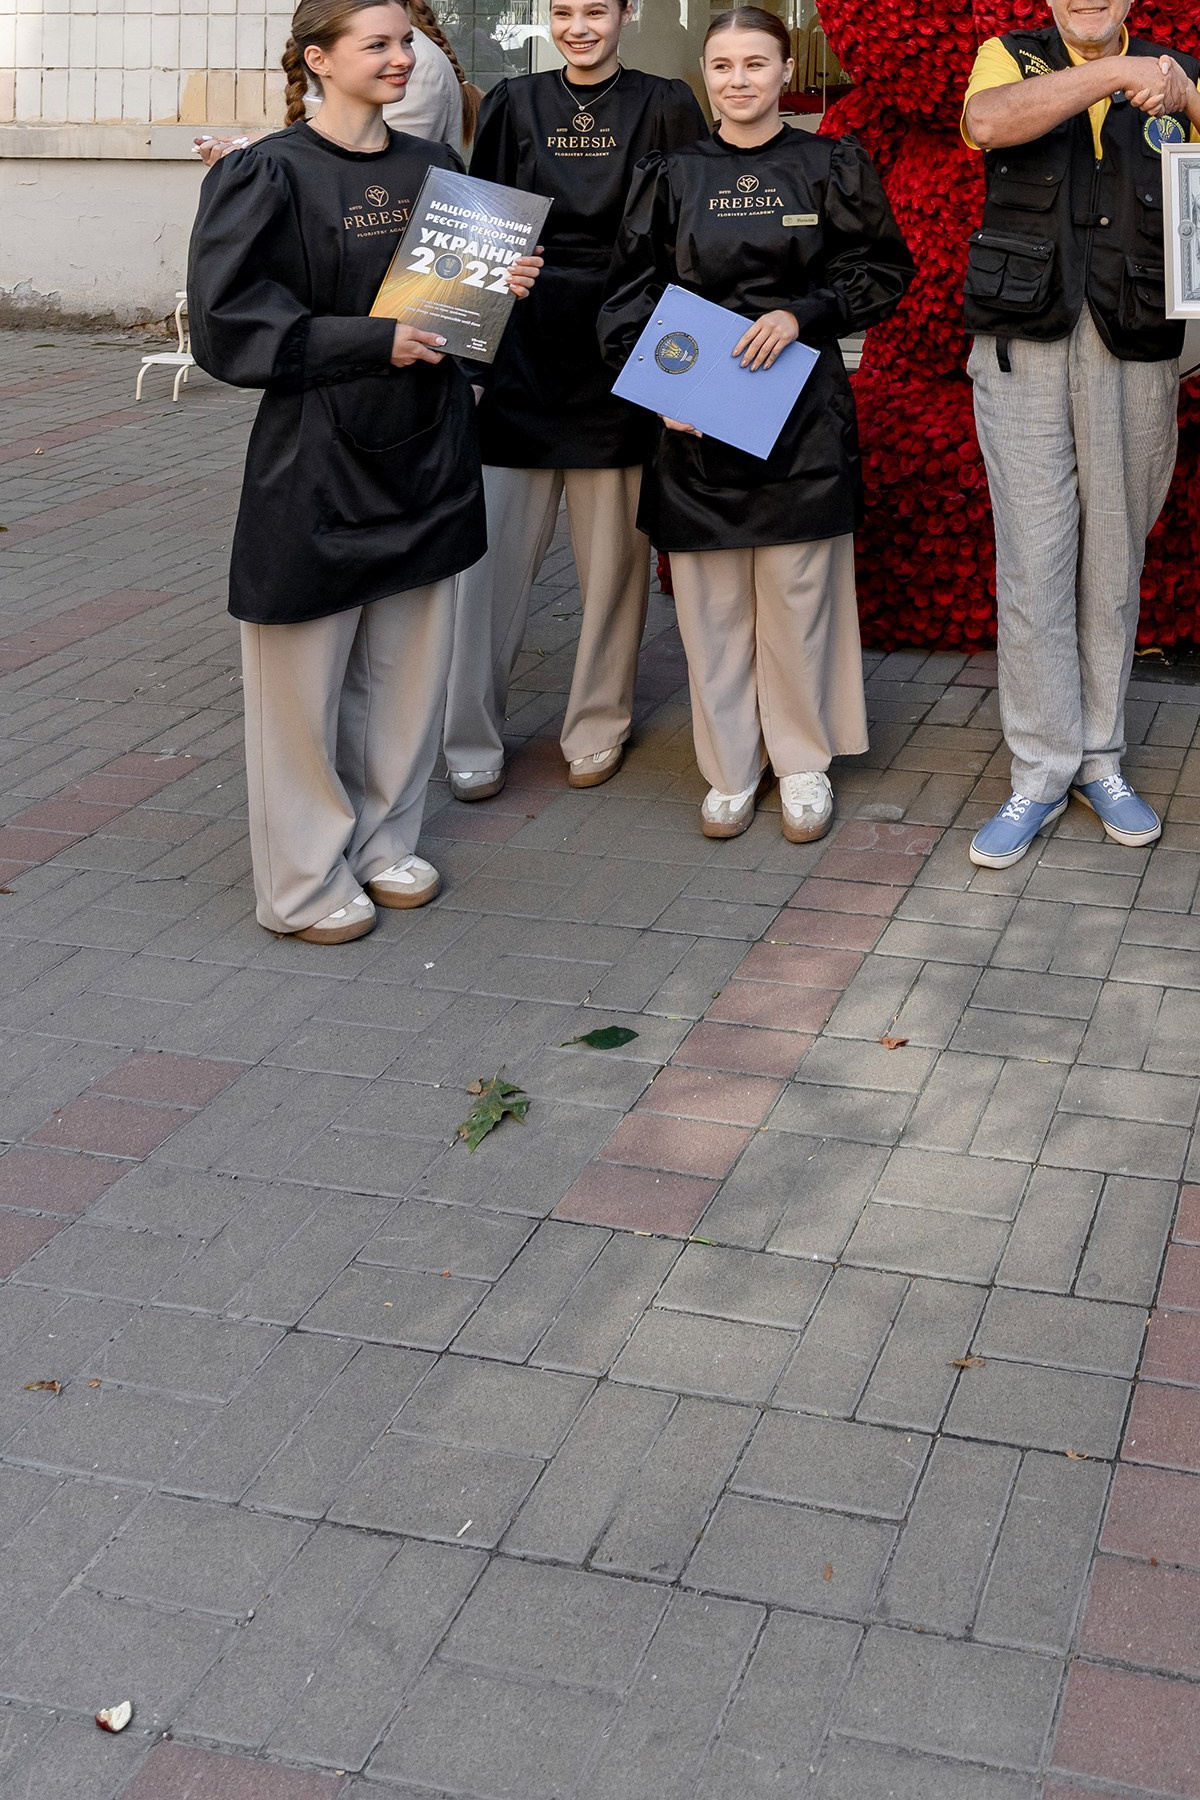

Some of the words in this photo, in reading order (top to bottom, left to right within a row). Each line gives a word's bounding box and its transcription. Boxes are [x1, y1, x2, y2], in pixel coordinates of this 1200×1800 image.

[547, 135, 617, 149] FREESIA
[430, 200, 533, 235] НАЦІОНАЛЬНИЙ
[708, 196, 785, 211] FREESIA
[343, 208, 410, 231] FREESI
[425, 213, 469, 230] РЕЄСТР
[470, 225, 528, 247] РЕКОРДІВ
[419, 227, 522, 266] УКРАЇНИ
